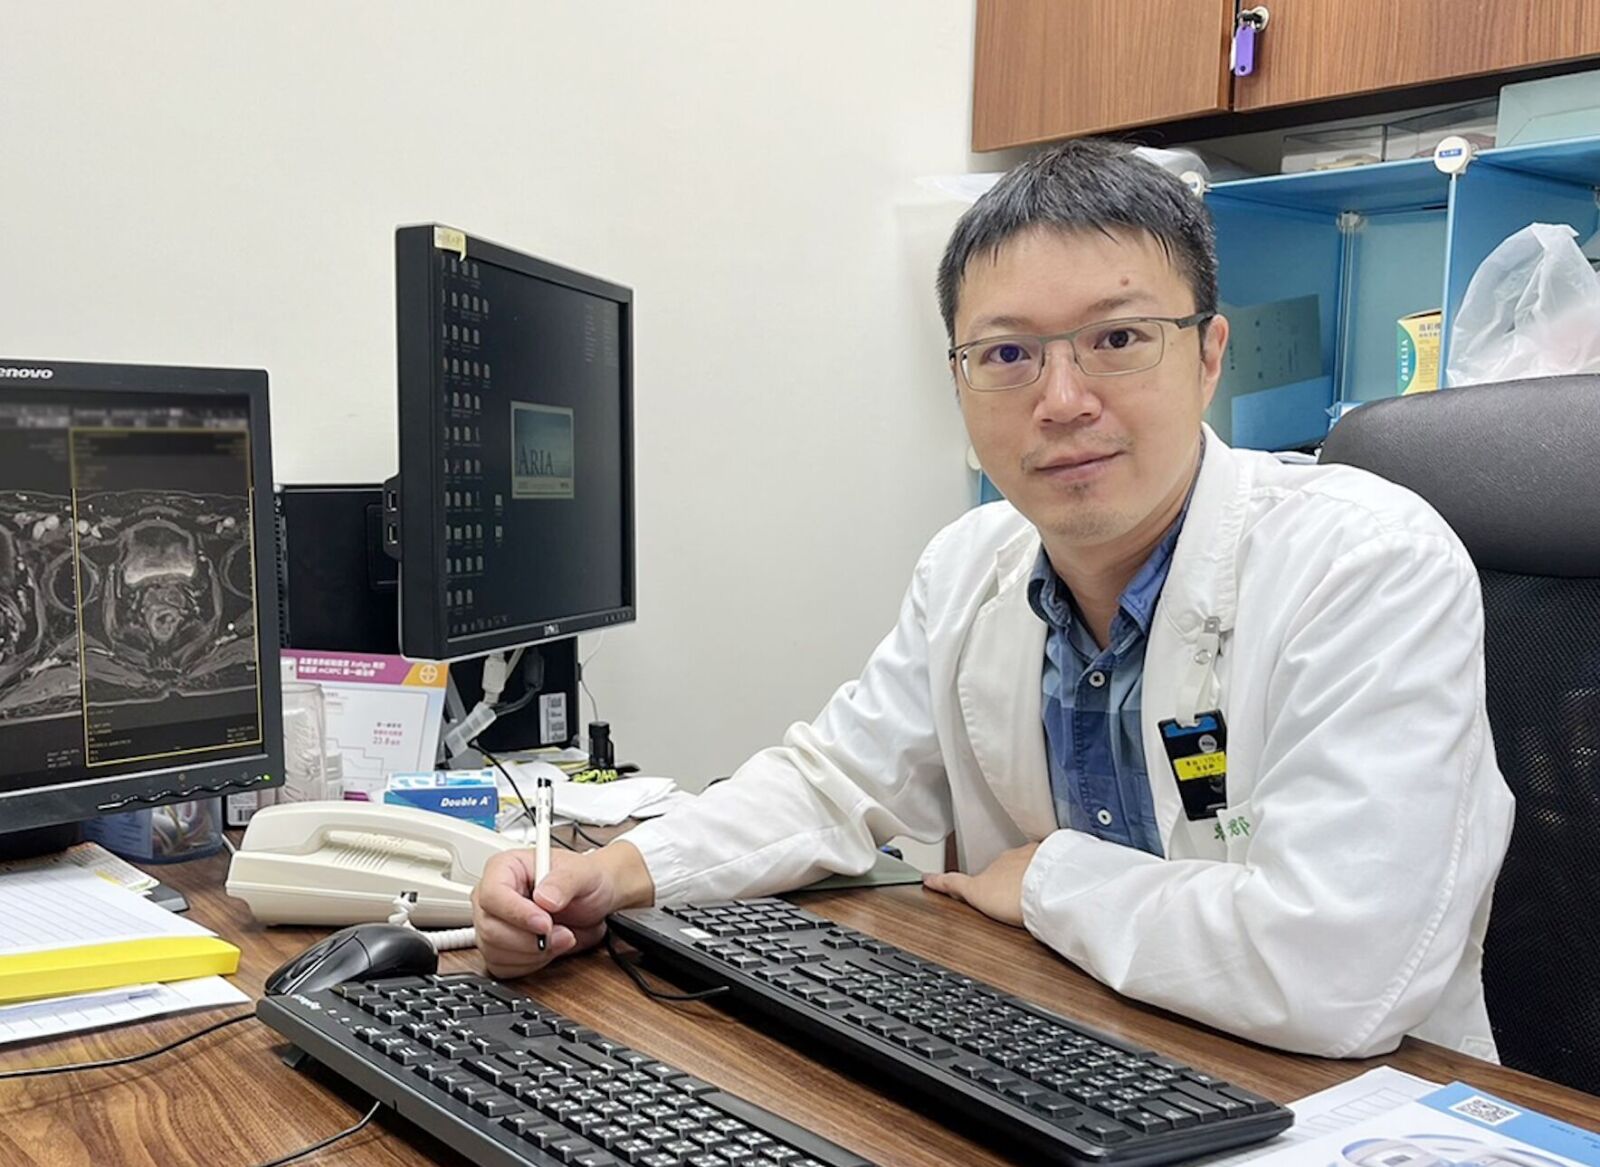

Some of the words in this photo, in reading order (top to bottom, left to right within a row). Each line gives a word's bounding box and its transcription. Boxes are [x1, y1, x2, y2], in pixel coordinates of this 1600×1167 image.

[518, 444, 554, 476] ARIA
[440, 797, 477, 808] Double
[479, 796, 489, 806] A
